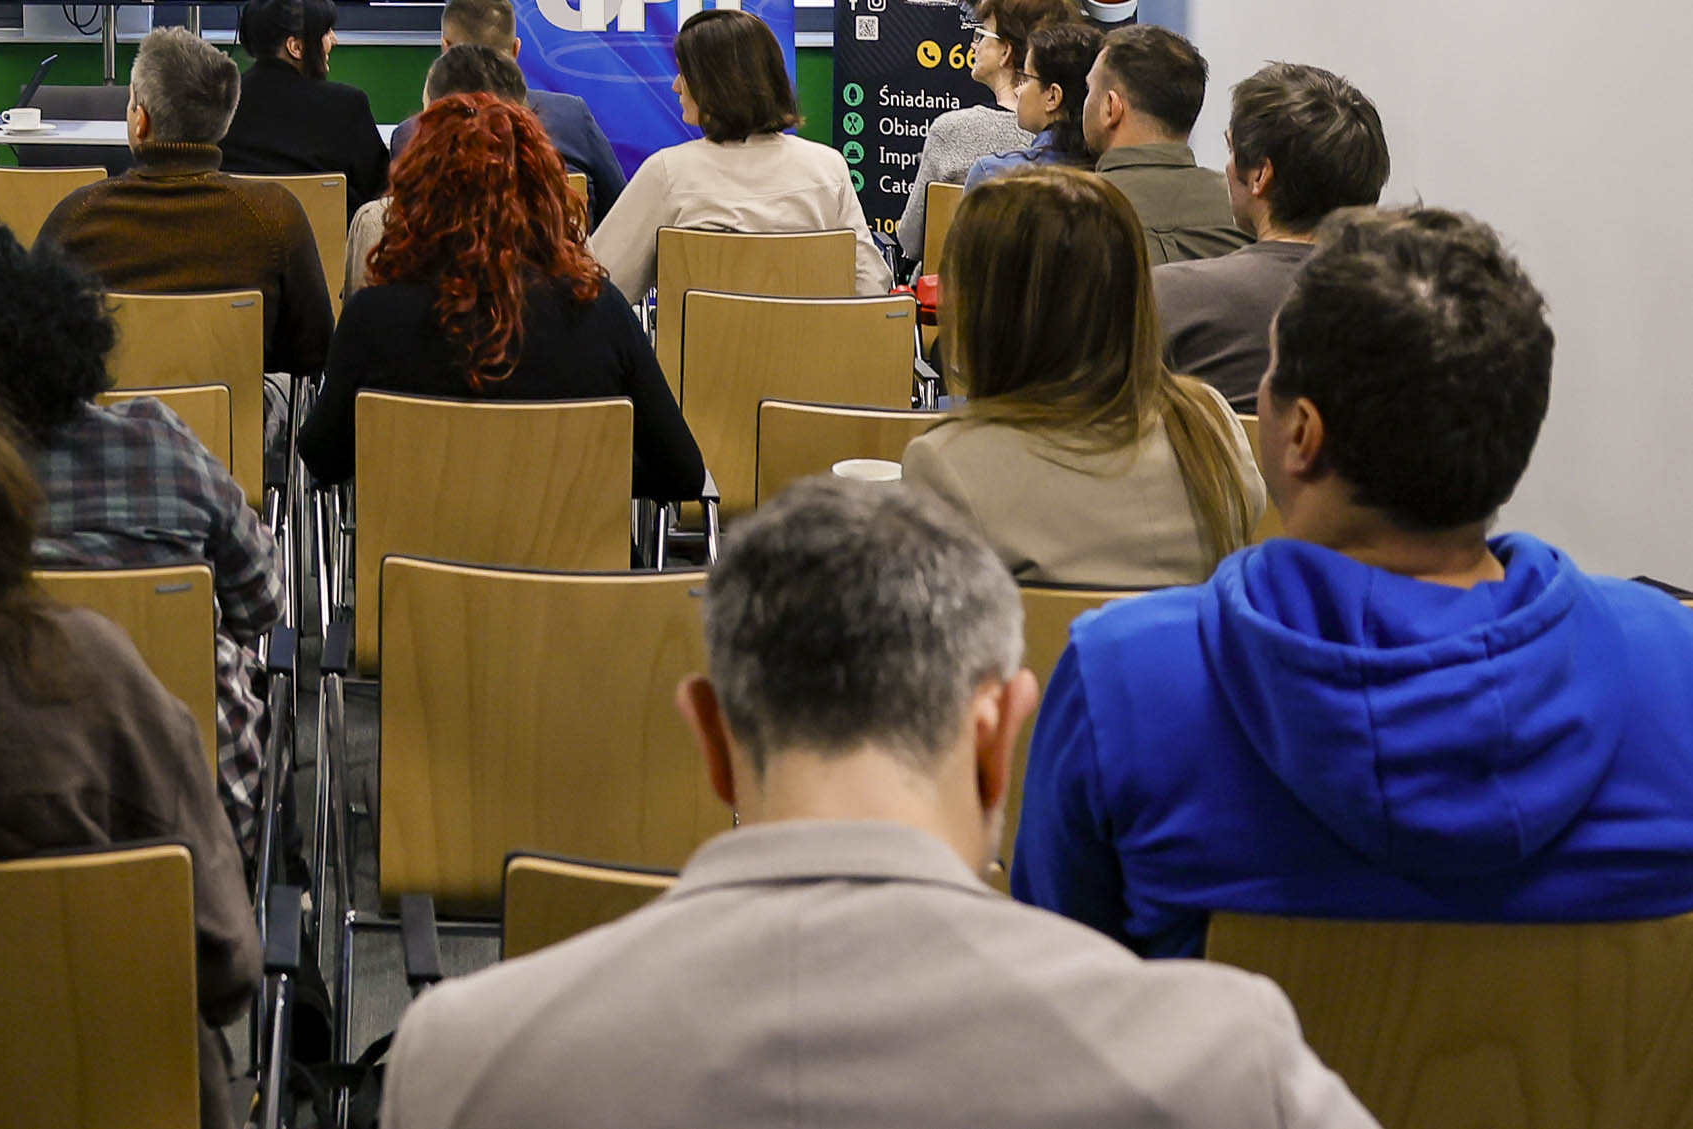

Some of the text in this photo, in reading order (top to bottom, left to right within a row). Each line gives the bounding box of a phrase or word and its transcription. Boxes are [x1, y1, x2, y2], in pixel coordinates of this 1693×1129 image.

[949, 43, 976, 70] 66
[879, 84, 960, 109] Śniadania
[879, 117, 930, 137] Obiad
[879, 146, 917, 171] Impr
[879, 175, 914, 195] Cate
